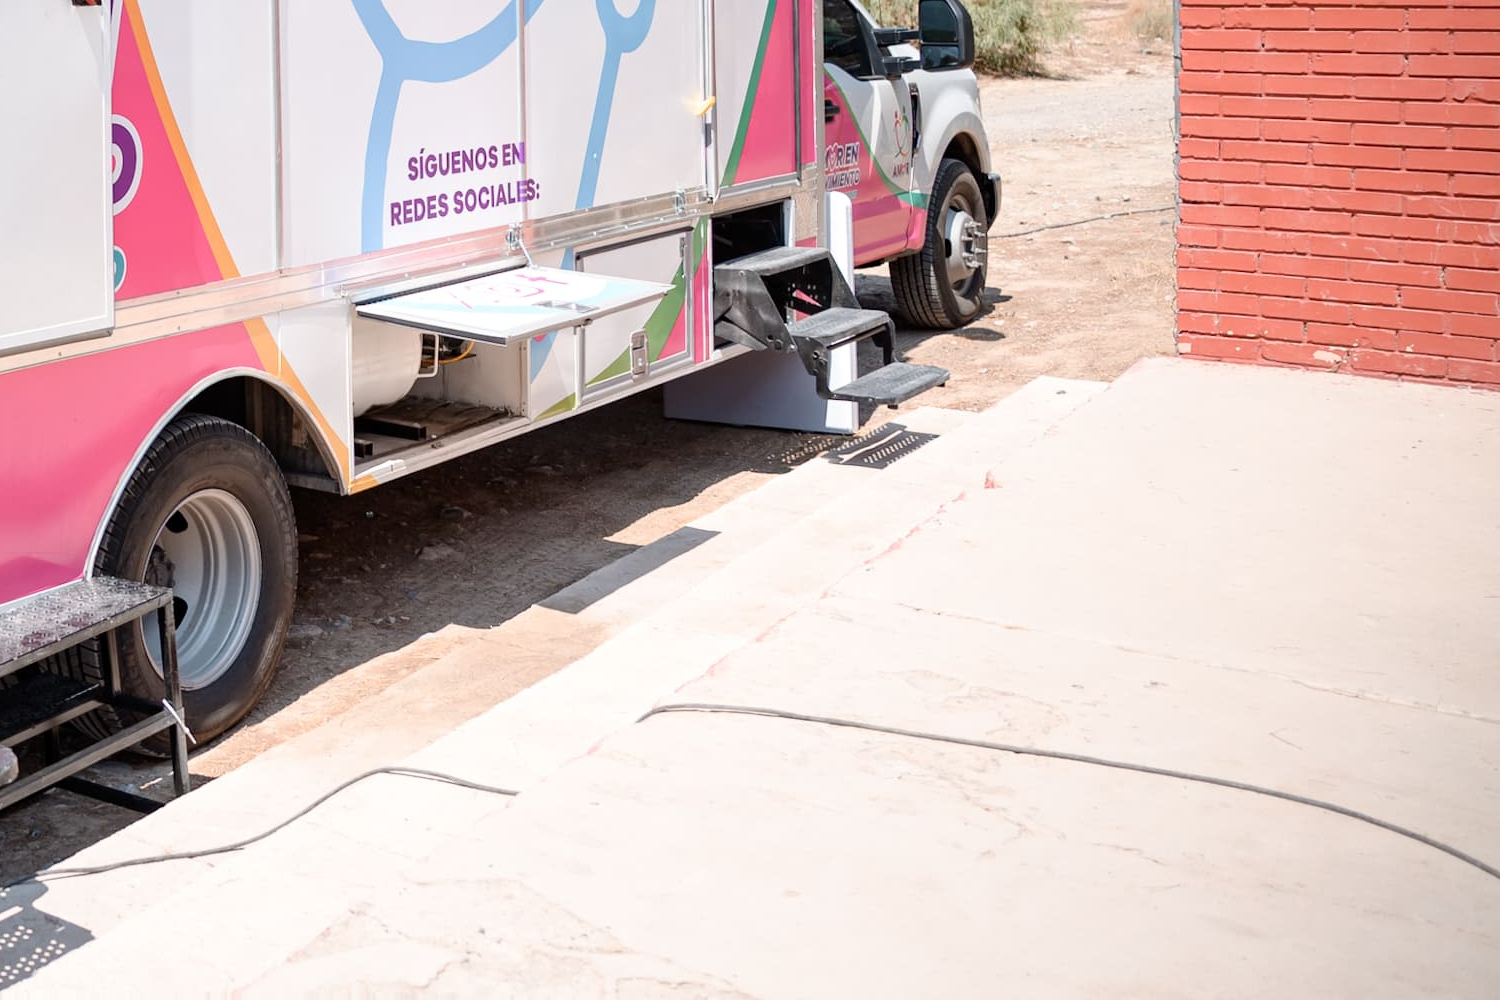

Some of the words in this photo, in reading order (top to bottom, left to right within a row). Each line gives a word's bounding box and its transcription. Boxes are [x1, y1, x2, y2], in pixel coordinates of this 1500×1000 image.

[408, 147, 498, 181] SÍGUENOS
[502, 141, 525, 167] EN
[390, 193, 449, 226] REDES
[453, 178, 540, 215] SOCIALES:
